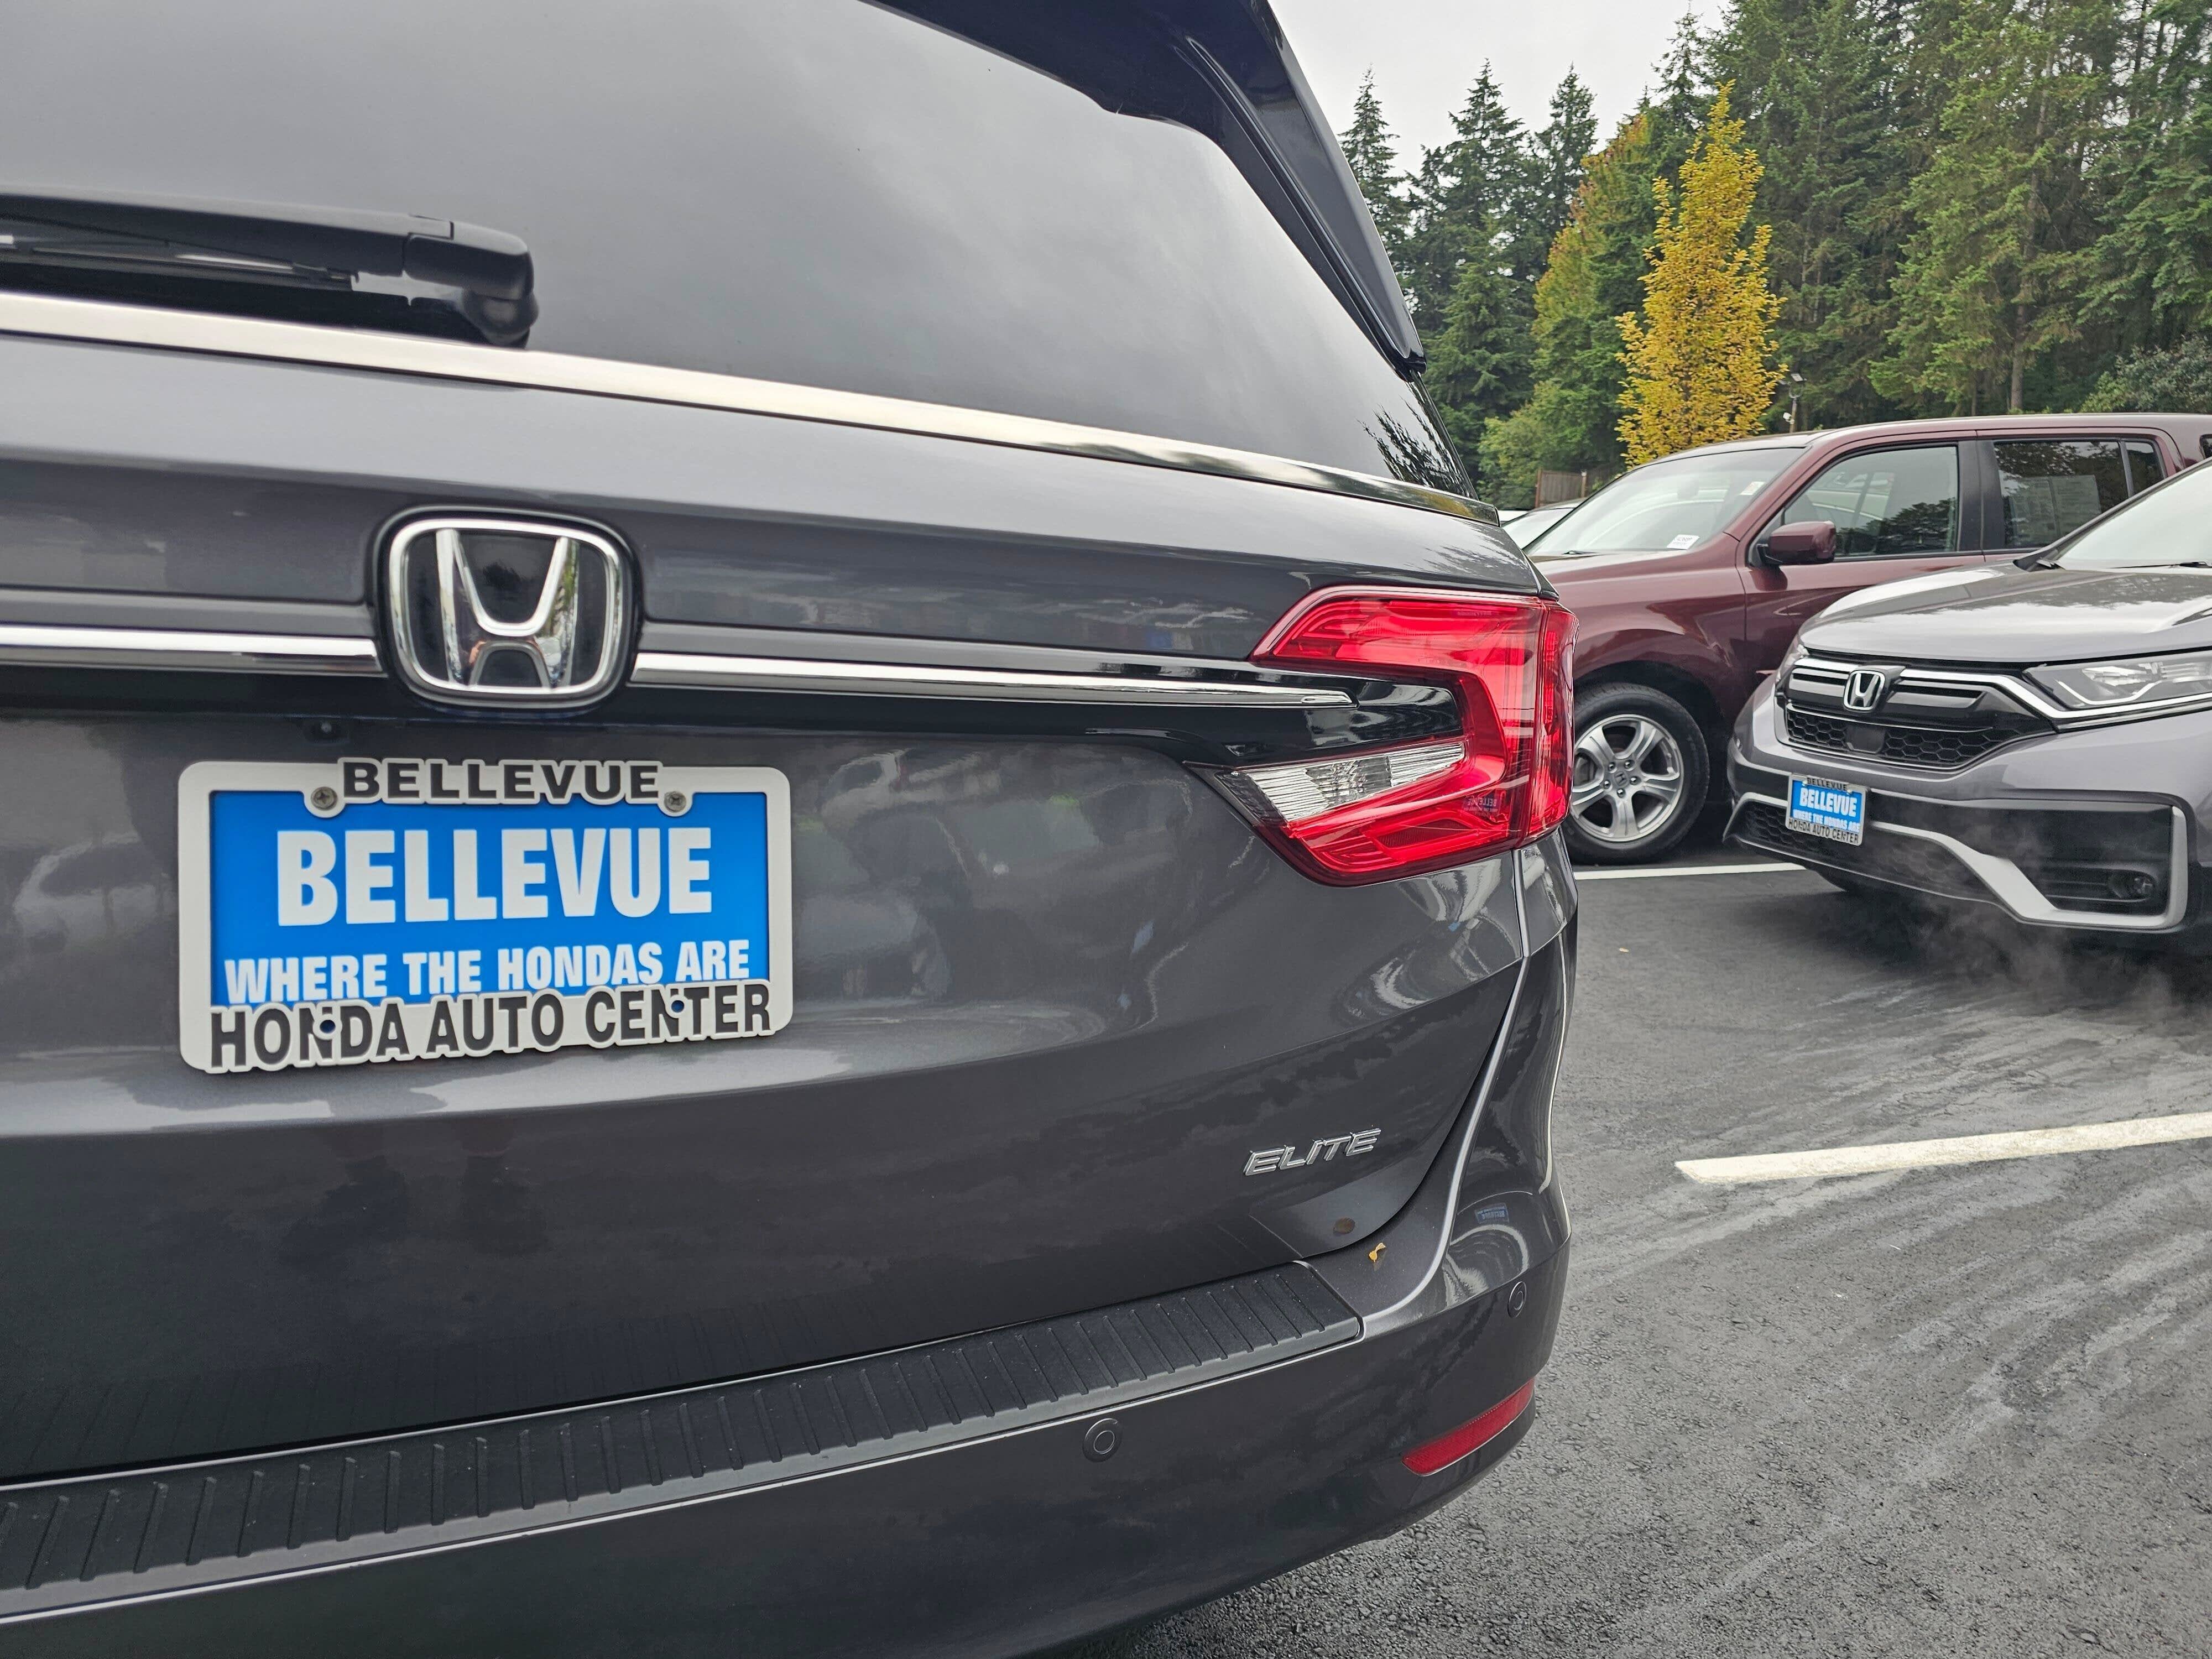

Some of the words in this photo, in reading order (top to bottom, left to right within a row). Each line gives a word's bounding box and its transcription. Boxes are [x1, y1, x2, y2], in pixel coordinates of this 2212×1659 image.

[344, 761, 660, 800] BELLEVUE
[1799, 787, 1858, 817] BELLEVUE
[1807, 777, 1848, 791] BELLEVUE
[1813, 824, 1830, 837] AUTO
[1832, 828, 1859, 845] CENTER
[276, 827, 712, 927] BELLEVUE
[224, 954, 387, 1004] WHERE
[403, 949, 481, 997] THE
[498, 943, 663, 991] HONDAS
[675, 940, 750, 984] ARE
[211, 1002, 411, 1069] HONDA
[427, 993, 564, 1053] AUTO
[585, 984, 771, 1041] CENTER
[1243, 1128, 1381, 1176] ELITE
